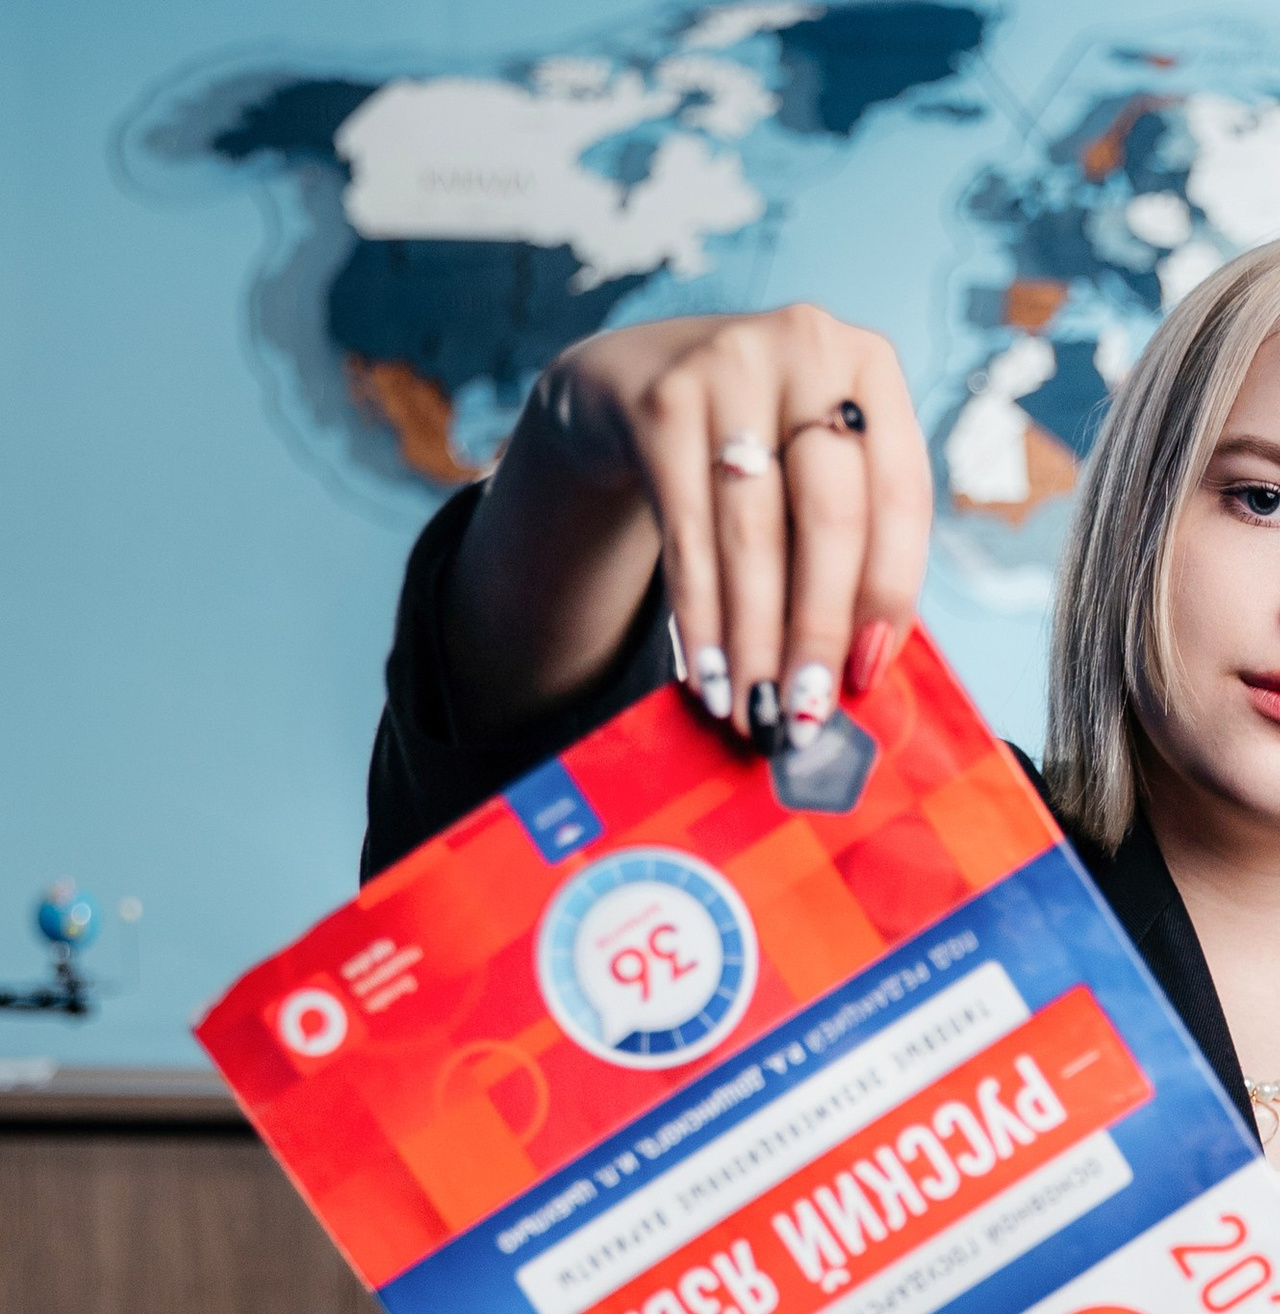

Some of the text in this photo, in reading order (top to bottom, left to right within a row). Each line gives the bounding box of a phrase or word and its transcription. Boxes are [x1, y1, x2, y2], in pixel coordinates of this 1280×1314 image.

[610, 922, 699, 1007] 36
[925, 924, 981, 972] ПОД
[799, 956, 932, 1055] РЕДАКЦИЕЙ
[554, 996, 991, 1292] ТИПОВЫЕ ЭКЗАМЕНАЦИОННЫЕ ВАРИАНТЫ
[768, 1050, 1069, 1295] РУССКИЙ
[979, 1154, 1105, 1248] ОСНОВНОЙ
